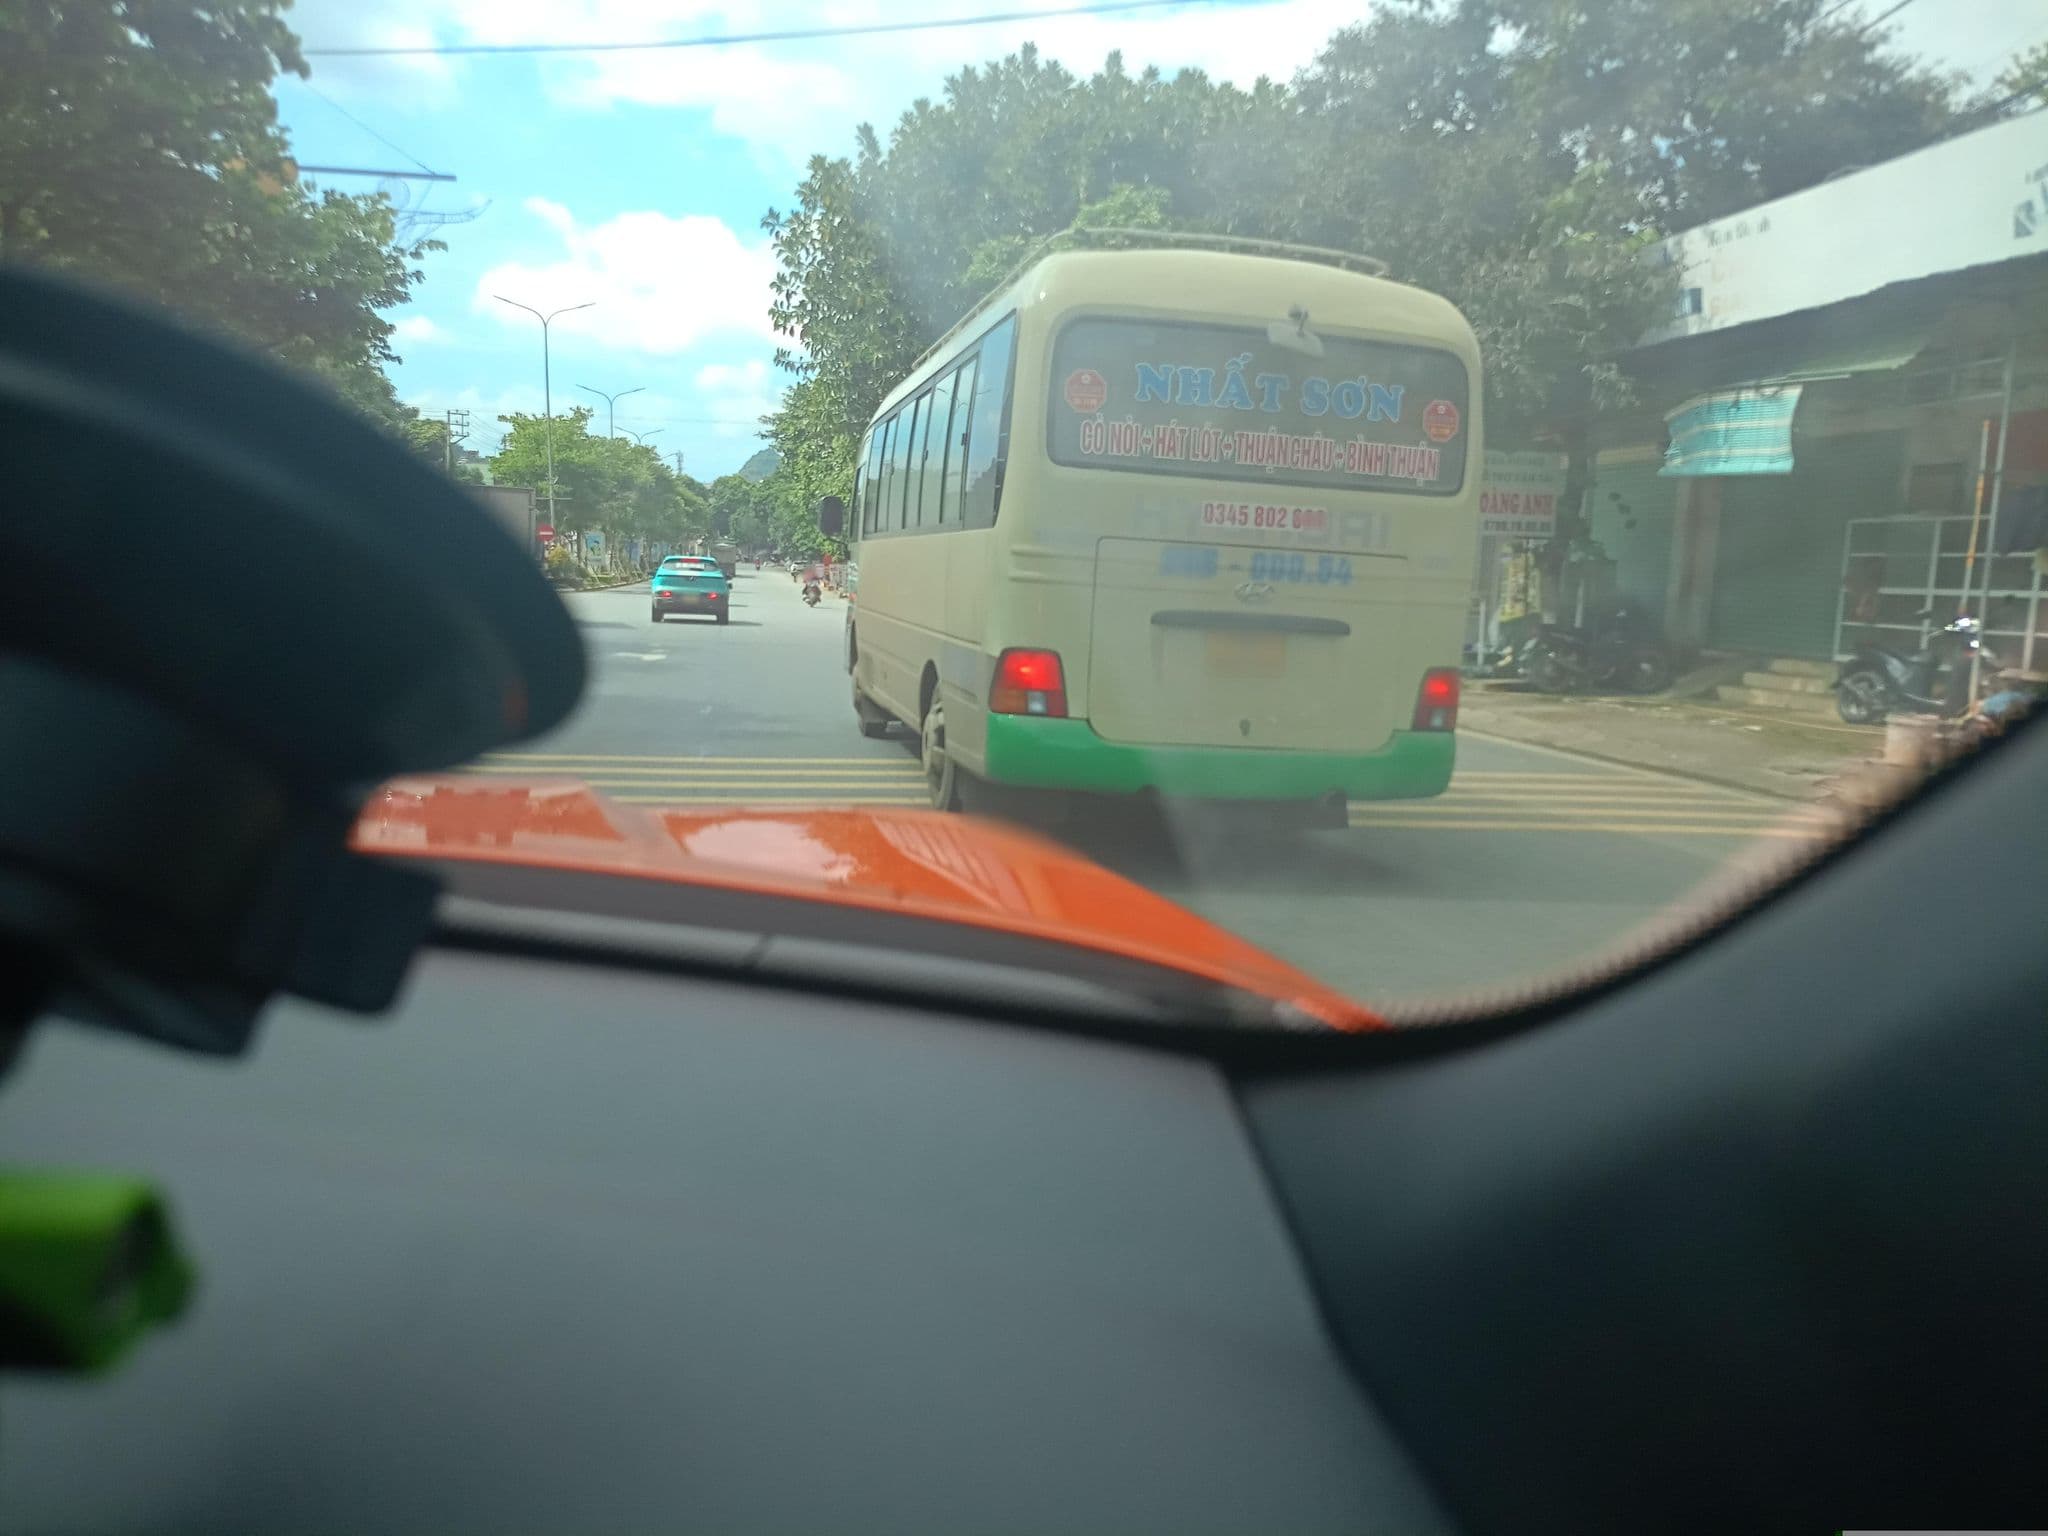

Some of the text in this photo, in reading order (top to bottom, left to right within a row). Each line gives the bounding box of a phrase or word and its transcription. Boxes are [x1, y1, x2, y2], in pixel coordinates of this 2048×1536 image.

[1135, 352, 1290, 413] NHẤT
[1300, 376, 1405, 423] SƠN
[1153, 418, 1189, 460] HÁT
[1234, 425, 1289, 474] THUẬN
[1290, 431, 1335, 472] CHÂU
[1345, 433, 1387, 476] BÌNH
[1388, 440, 1440, 487] THUẬN
[1203, 502, 1249, 527] 0345
[1254, 505, 1288, 529] 802
